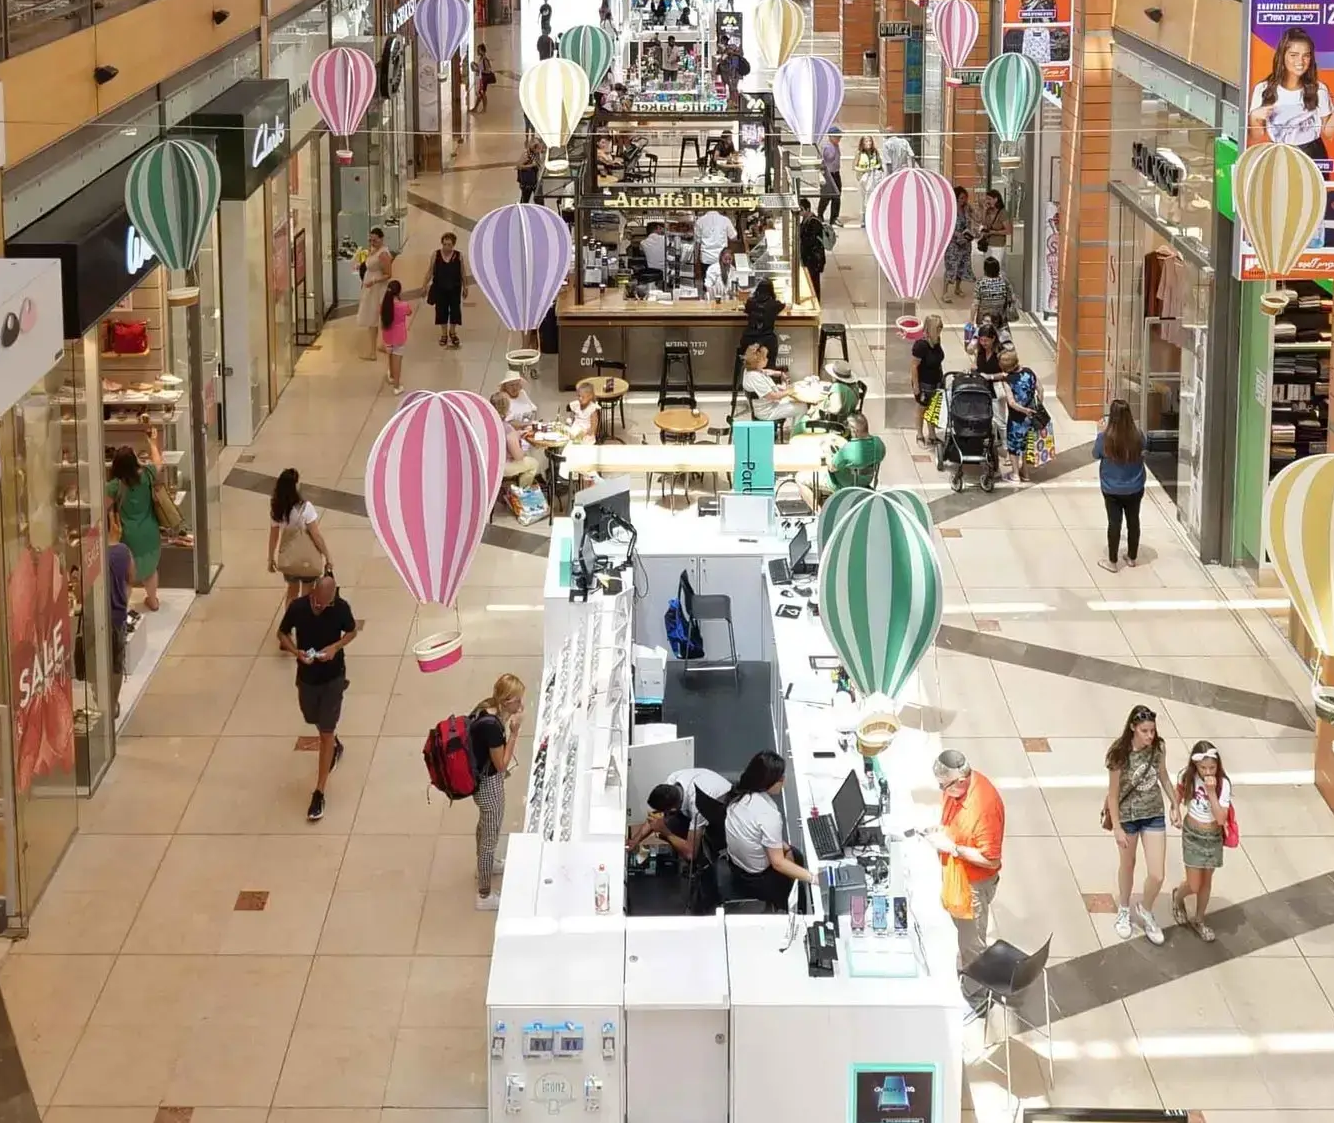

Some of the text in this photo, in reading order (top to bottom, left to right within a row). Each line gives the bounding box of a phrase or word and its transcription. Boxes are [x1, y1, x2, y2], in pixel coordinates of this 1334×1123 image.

[252, 115, 285, 168] Clarks
[615, 191, 760, 212] Arcaffé Bakery
[19, 618, 64, 709] SALE
